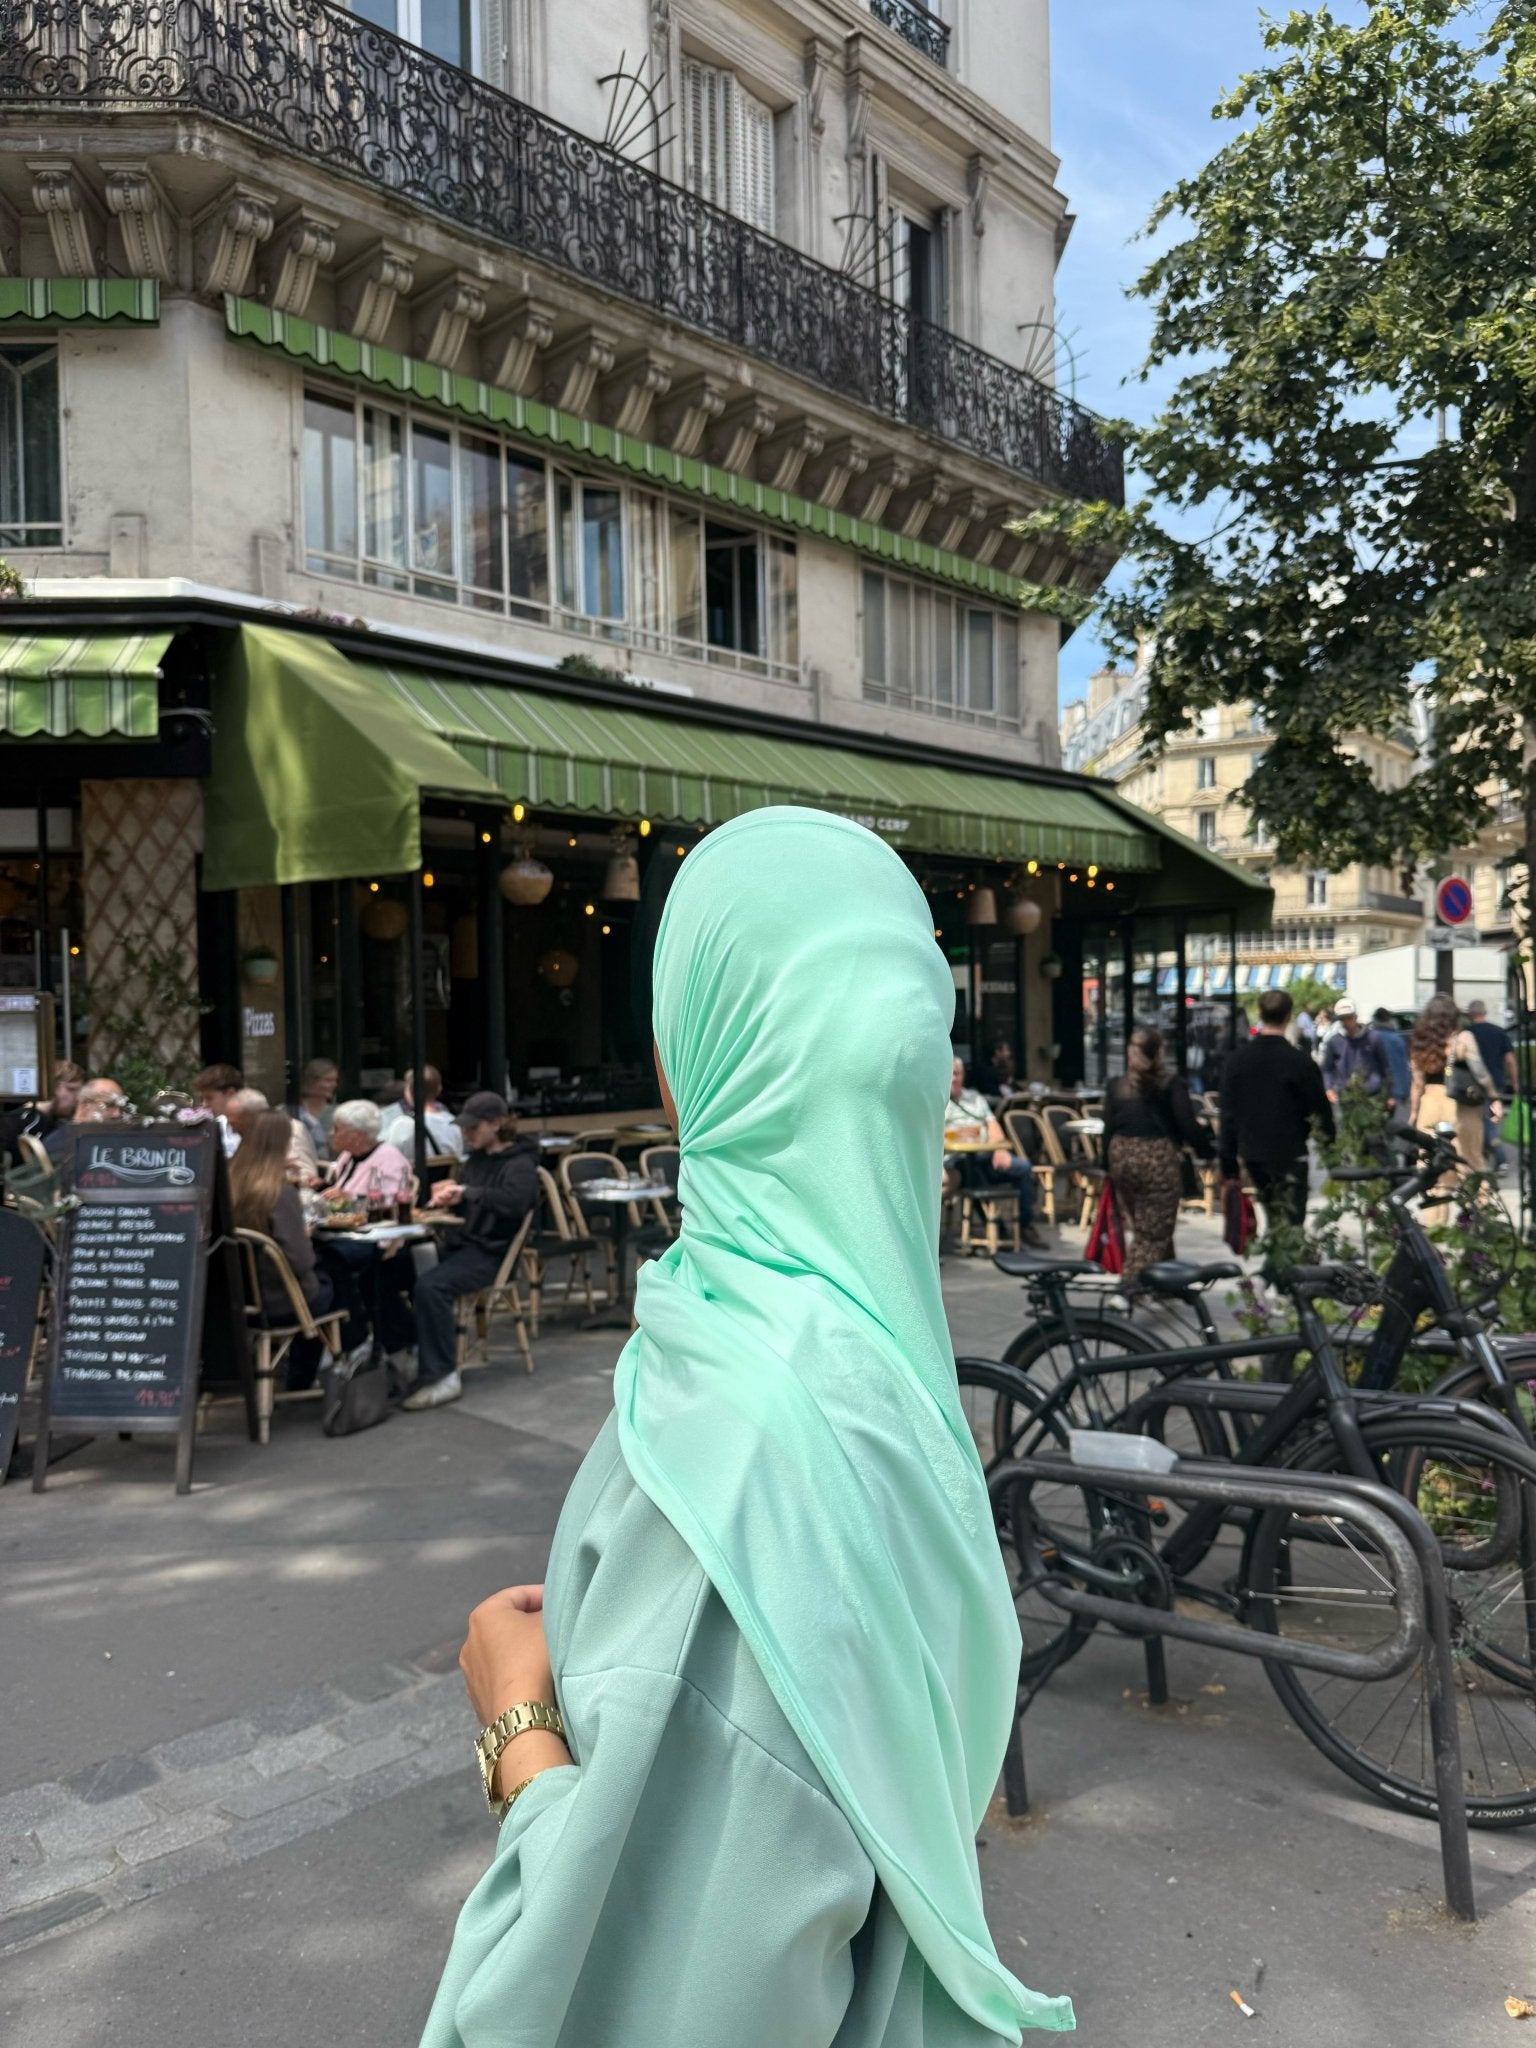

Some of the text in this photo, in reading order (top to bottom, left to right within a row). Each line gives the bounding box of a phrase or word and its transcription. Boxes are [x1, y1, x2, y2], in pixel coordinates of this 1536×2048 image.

[242, 1006, 275, 1037] Pizzas
[92, 1145, 186, 1168] LE BRUNCH
[1475, 1808, 1525, 1819] CONTACT
